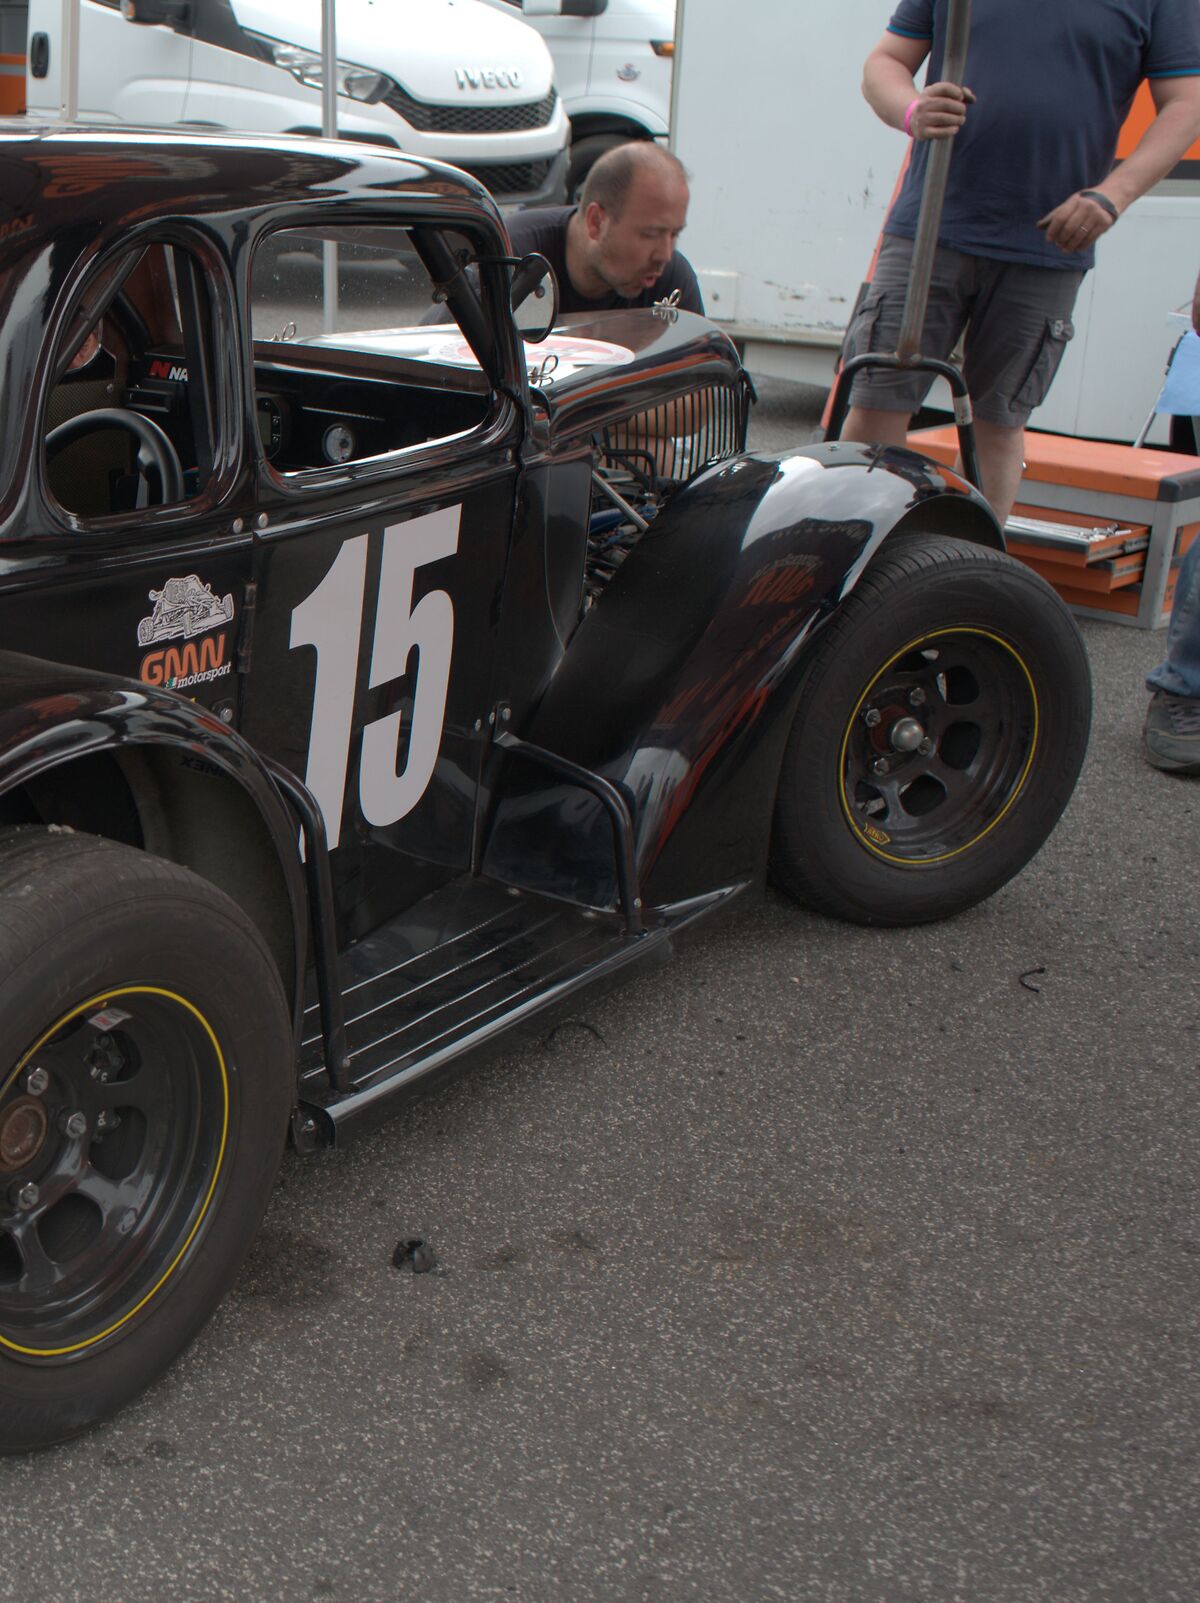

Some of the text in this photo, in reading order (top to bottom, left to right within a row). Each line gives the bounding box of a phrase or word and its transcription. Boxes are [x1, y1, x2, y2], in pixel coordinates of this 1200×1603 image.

[455, 67, 524, 90] IVECO
[177, 661, 231, 689] motorsport
[289, 503, 463, 863] 15
